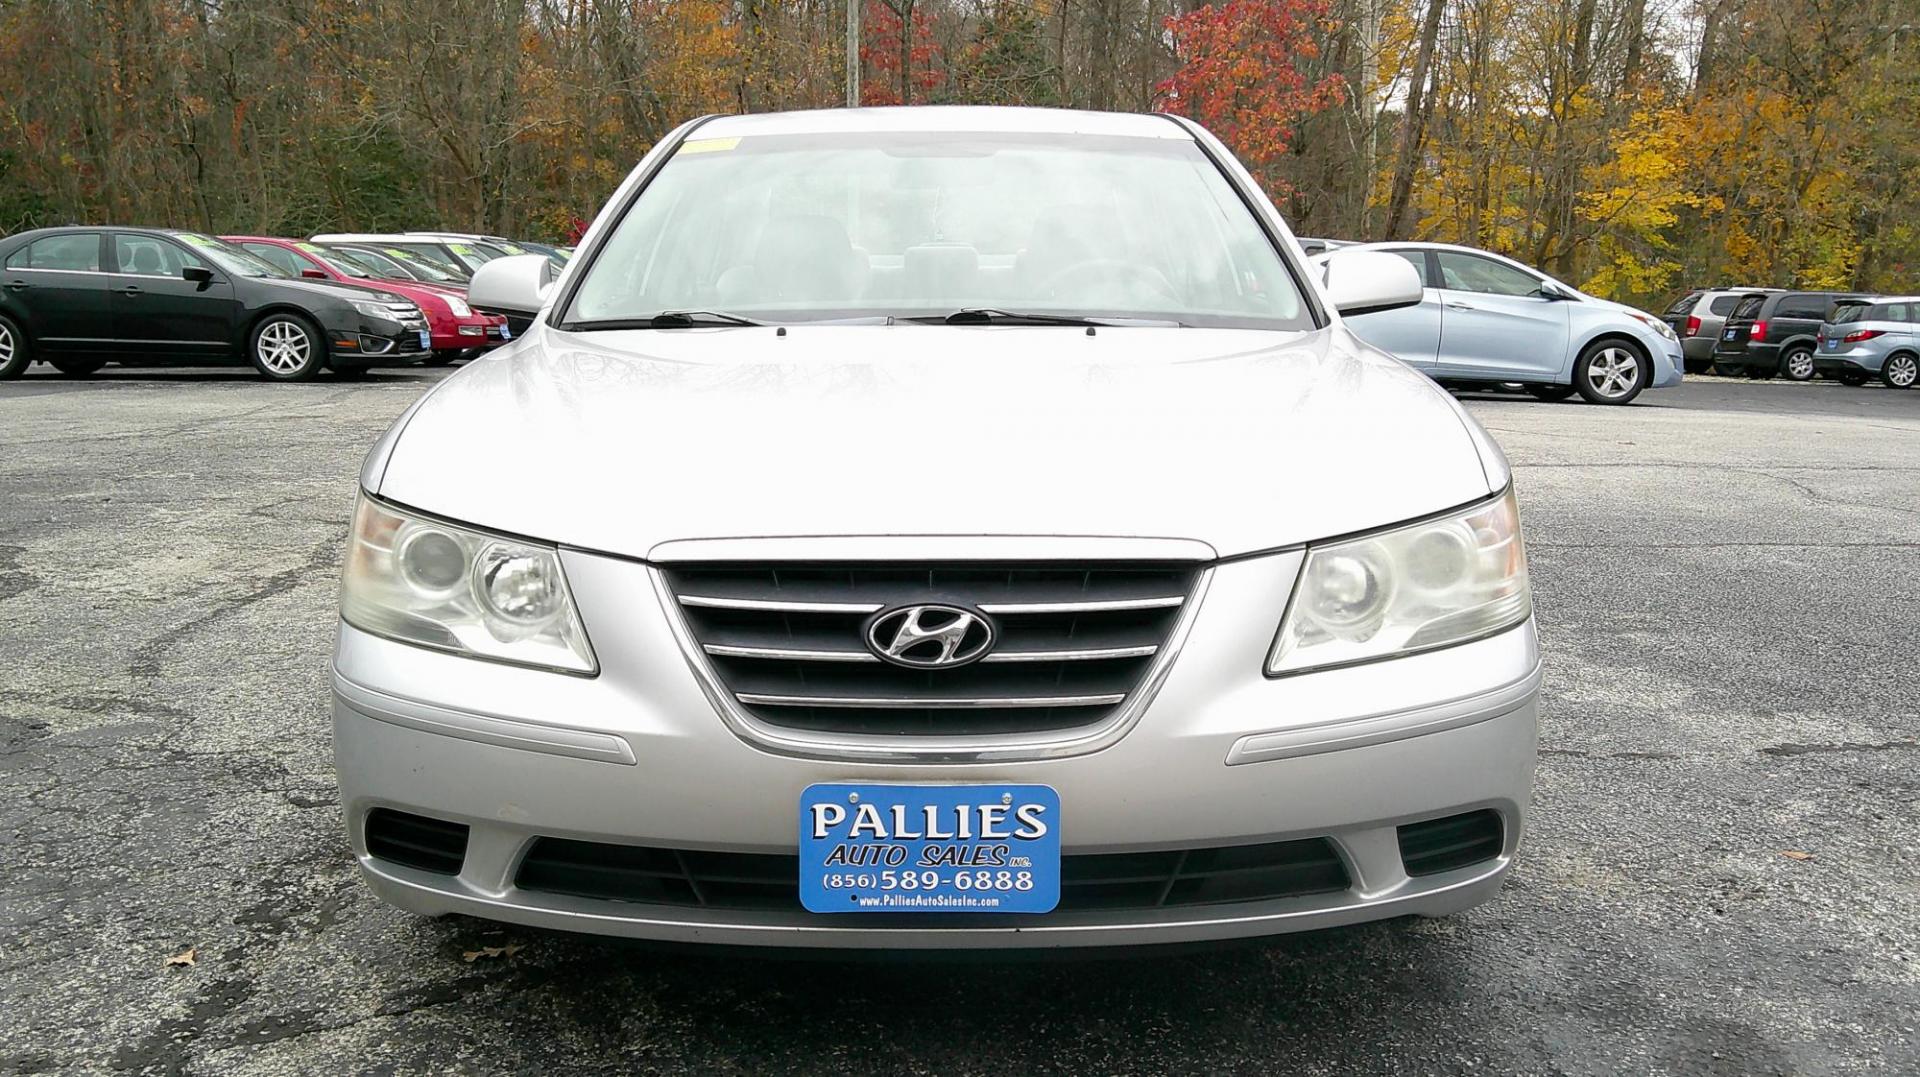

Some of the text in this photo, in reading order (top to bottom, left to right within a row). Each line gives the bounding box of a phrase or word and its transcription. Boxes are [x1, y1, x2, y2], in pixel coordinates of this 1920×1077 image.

[810, 803, 1048, 841] PALLIES
[824, 844, 909, 867] AUTO
[916, 844, 1009, 867] SALES
[823, 870, 1034, 891] (856) 589-6888
[859, 895, 999, 907] www.PalliesAutoSalesInc.com
